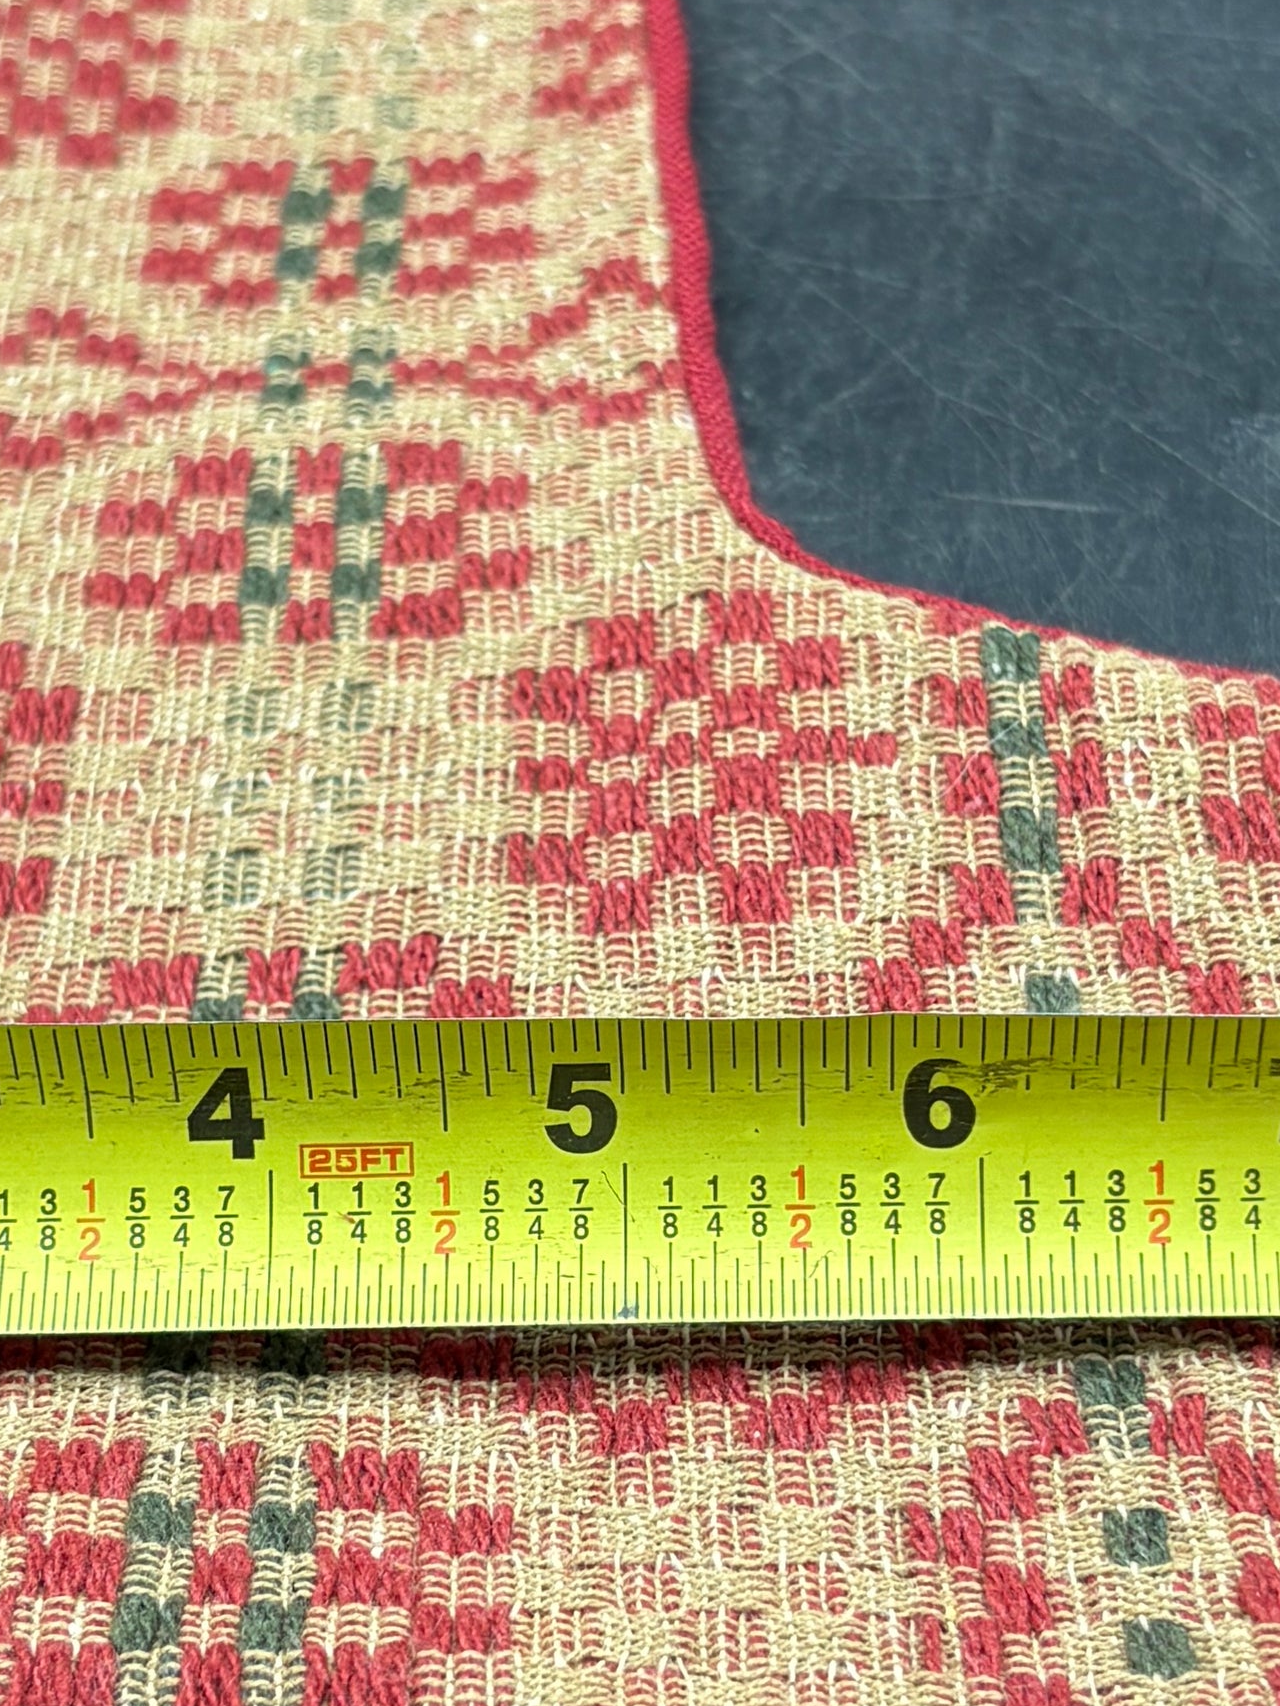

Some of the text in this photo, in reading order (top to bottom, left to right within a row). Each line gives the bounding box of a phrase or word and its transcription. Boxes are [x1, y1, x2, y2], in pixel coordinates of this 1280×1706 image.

[187, 1067, 265, 1159] 4
[544, 1062, 618, 1154] 5
[903, 1058, 976, 1149] 6
[307, 1148, 405, 1173] 25FT
